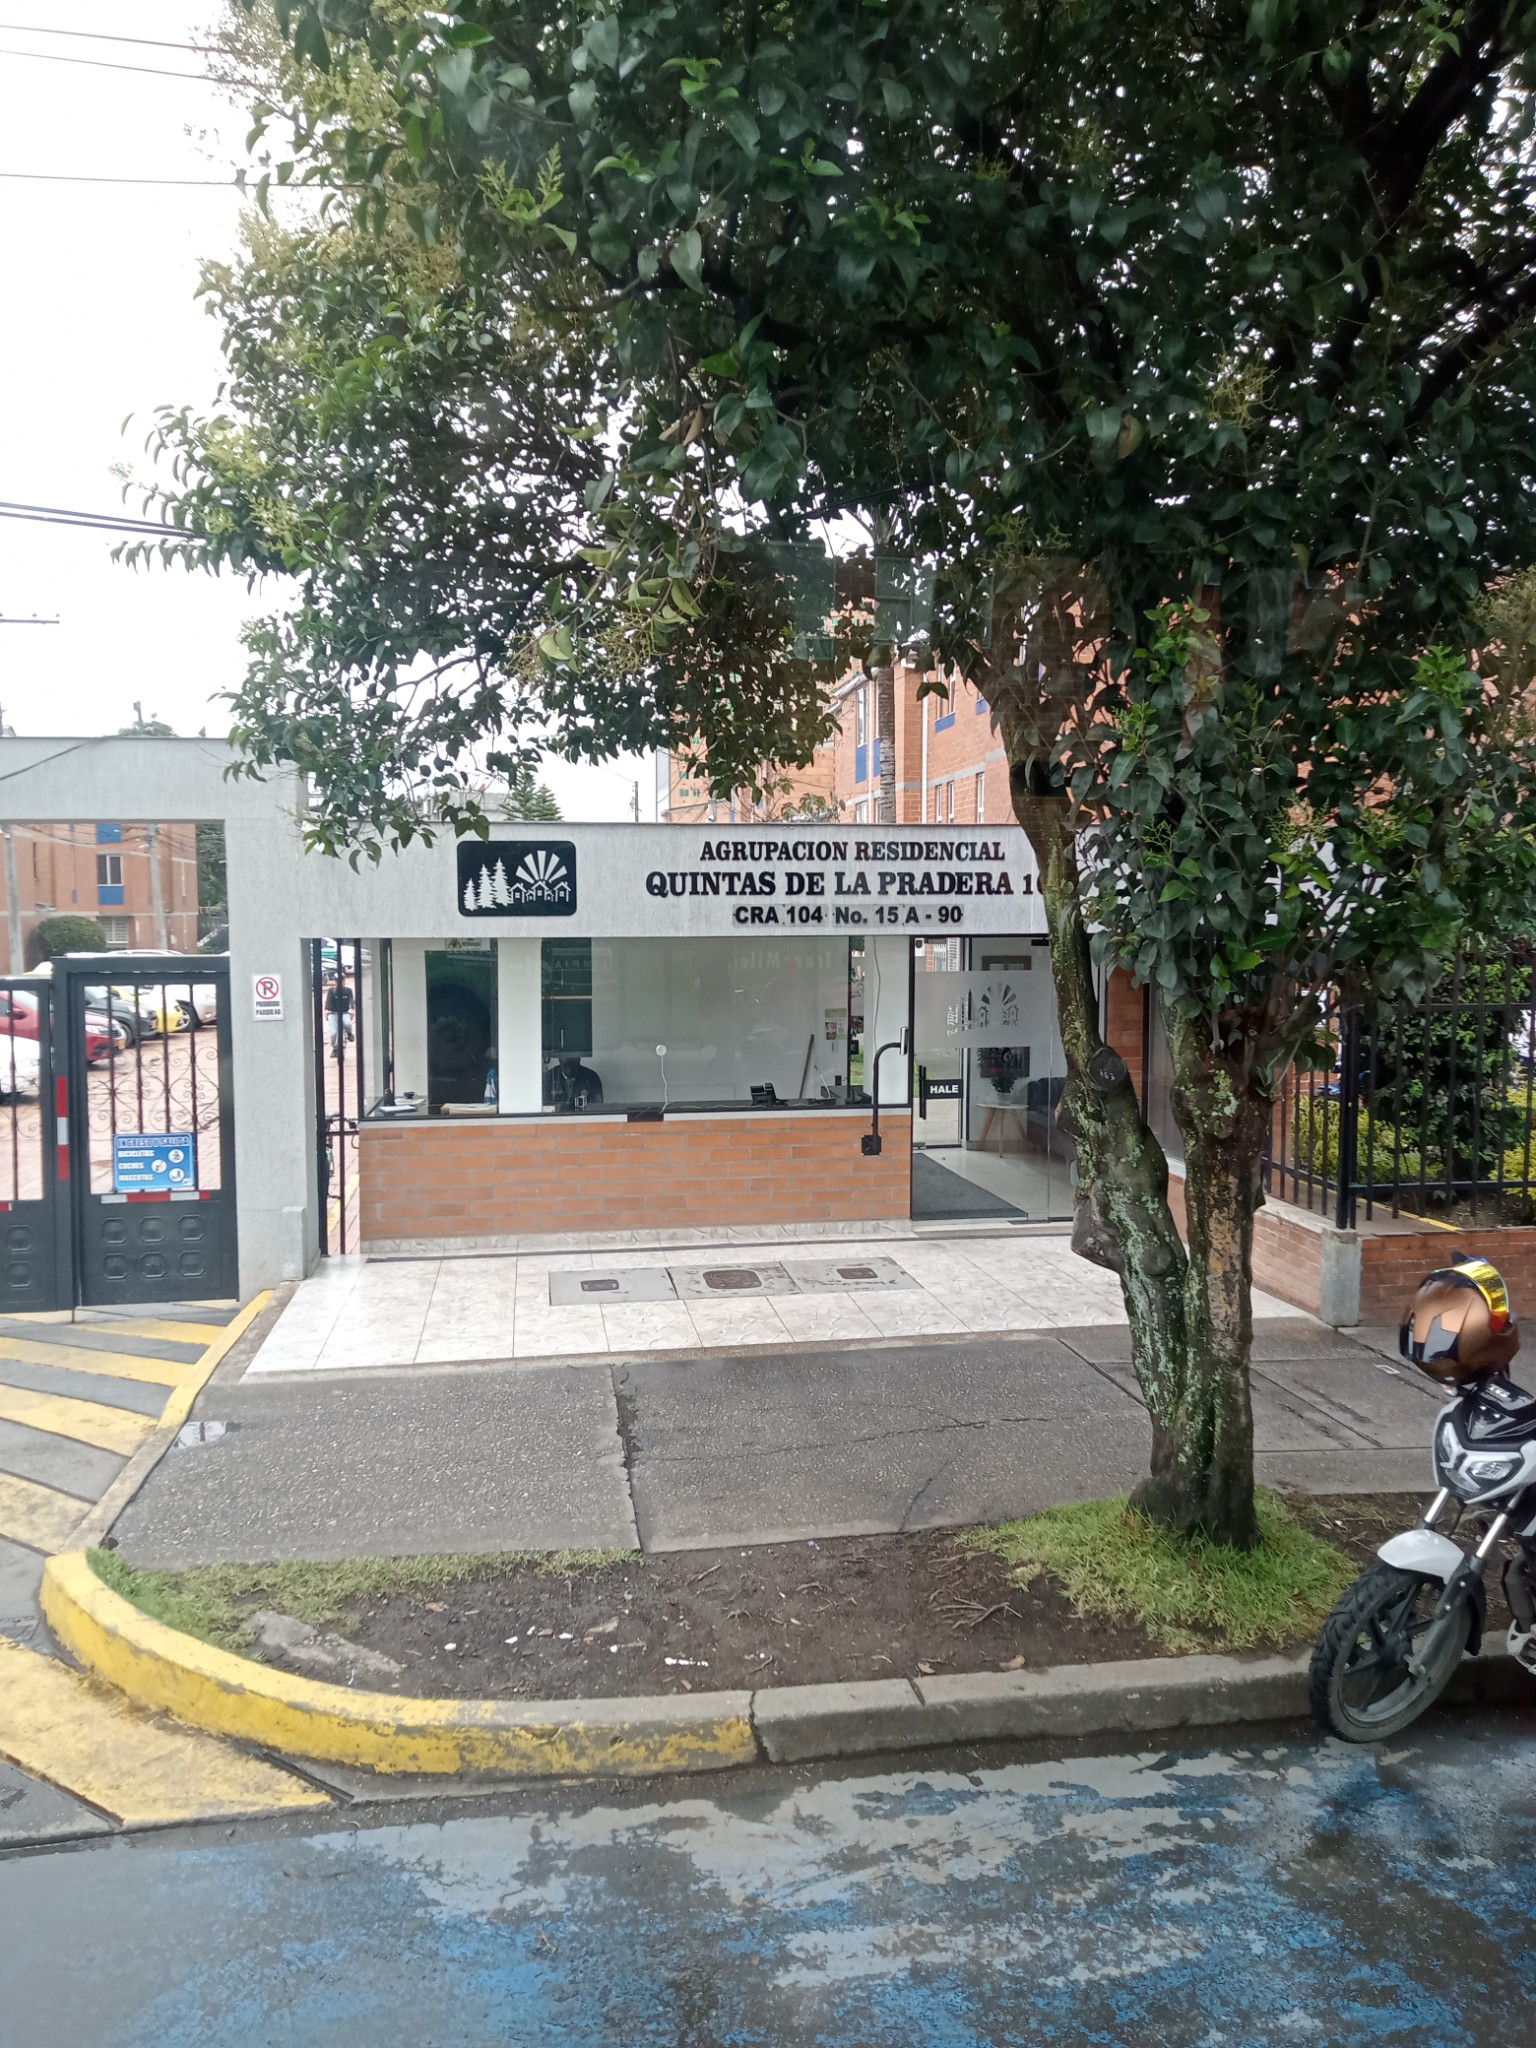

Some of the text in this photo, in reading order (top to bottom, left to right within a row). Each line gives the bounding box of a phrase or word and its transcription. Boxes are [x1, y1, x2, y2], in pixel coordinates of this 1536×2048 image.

[700, 841, 1005, 861] AGRUPACION RESIDENCIAL
[645, 871, 776, 898] QUINTAS
[785, 872, 825, 896] DE
[834, 872, 871, 895] LA
[877, 872, 1014, 895] PRADERA
[735, 906, 779, 924] CRA
[786, 906, 823, 924] 104
[835, 906, 868, 924] No.
[875, 906, 899, 924] 15
[905, 906, 920, 924] A
[938, 905, 962, 924] 90
[929, 1084, 959, 1094] HALE
